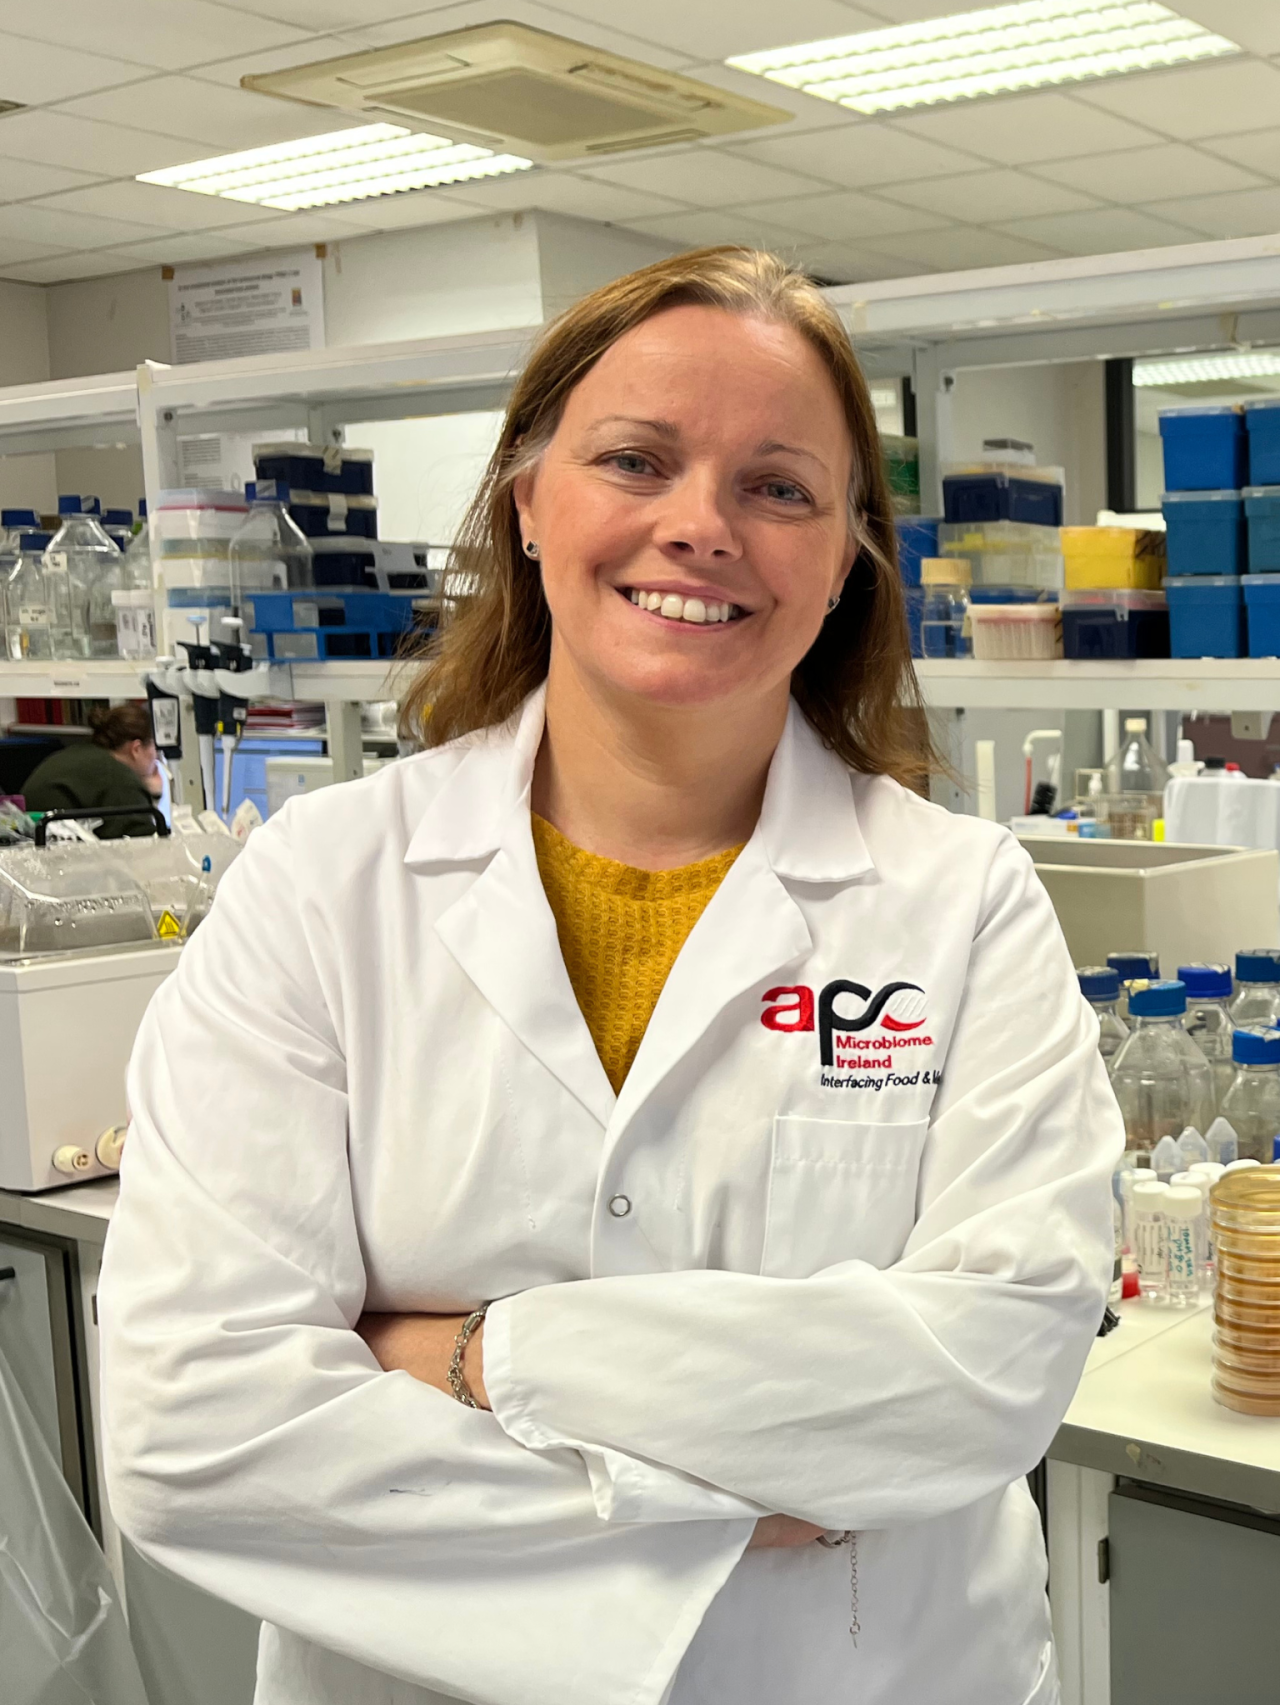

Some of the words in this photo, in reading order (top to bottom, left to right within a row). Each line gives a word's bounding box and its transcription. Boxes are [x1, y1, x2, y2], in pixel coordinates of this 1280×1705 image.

[836, 1035, 933, 1050] Microbiome
[836, 1055, 892, 1069] Ireland
[820, 1073, 884, 1091] Interfacing
[884, 1071, 920, 1087] Food
[922, 1070, 931, 1085] &
